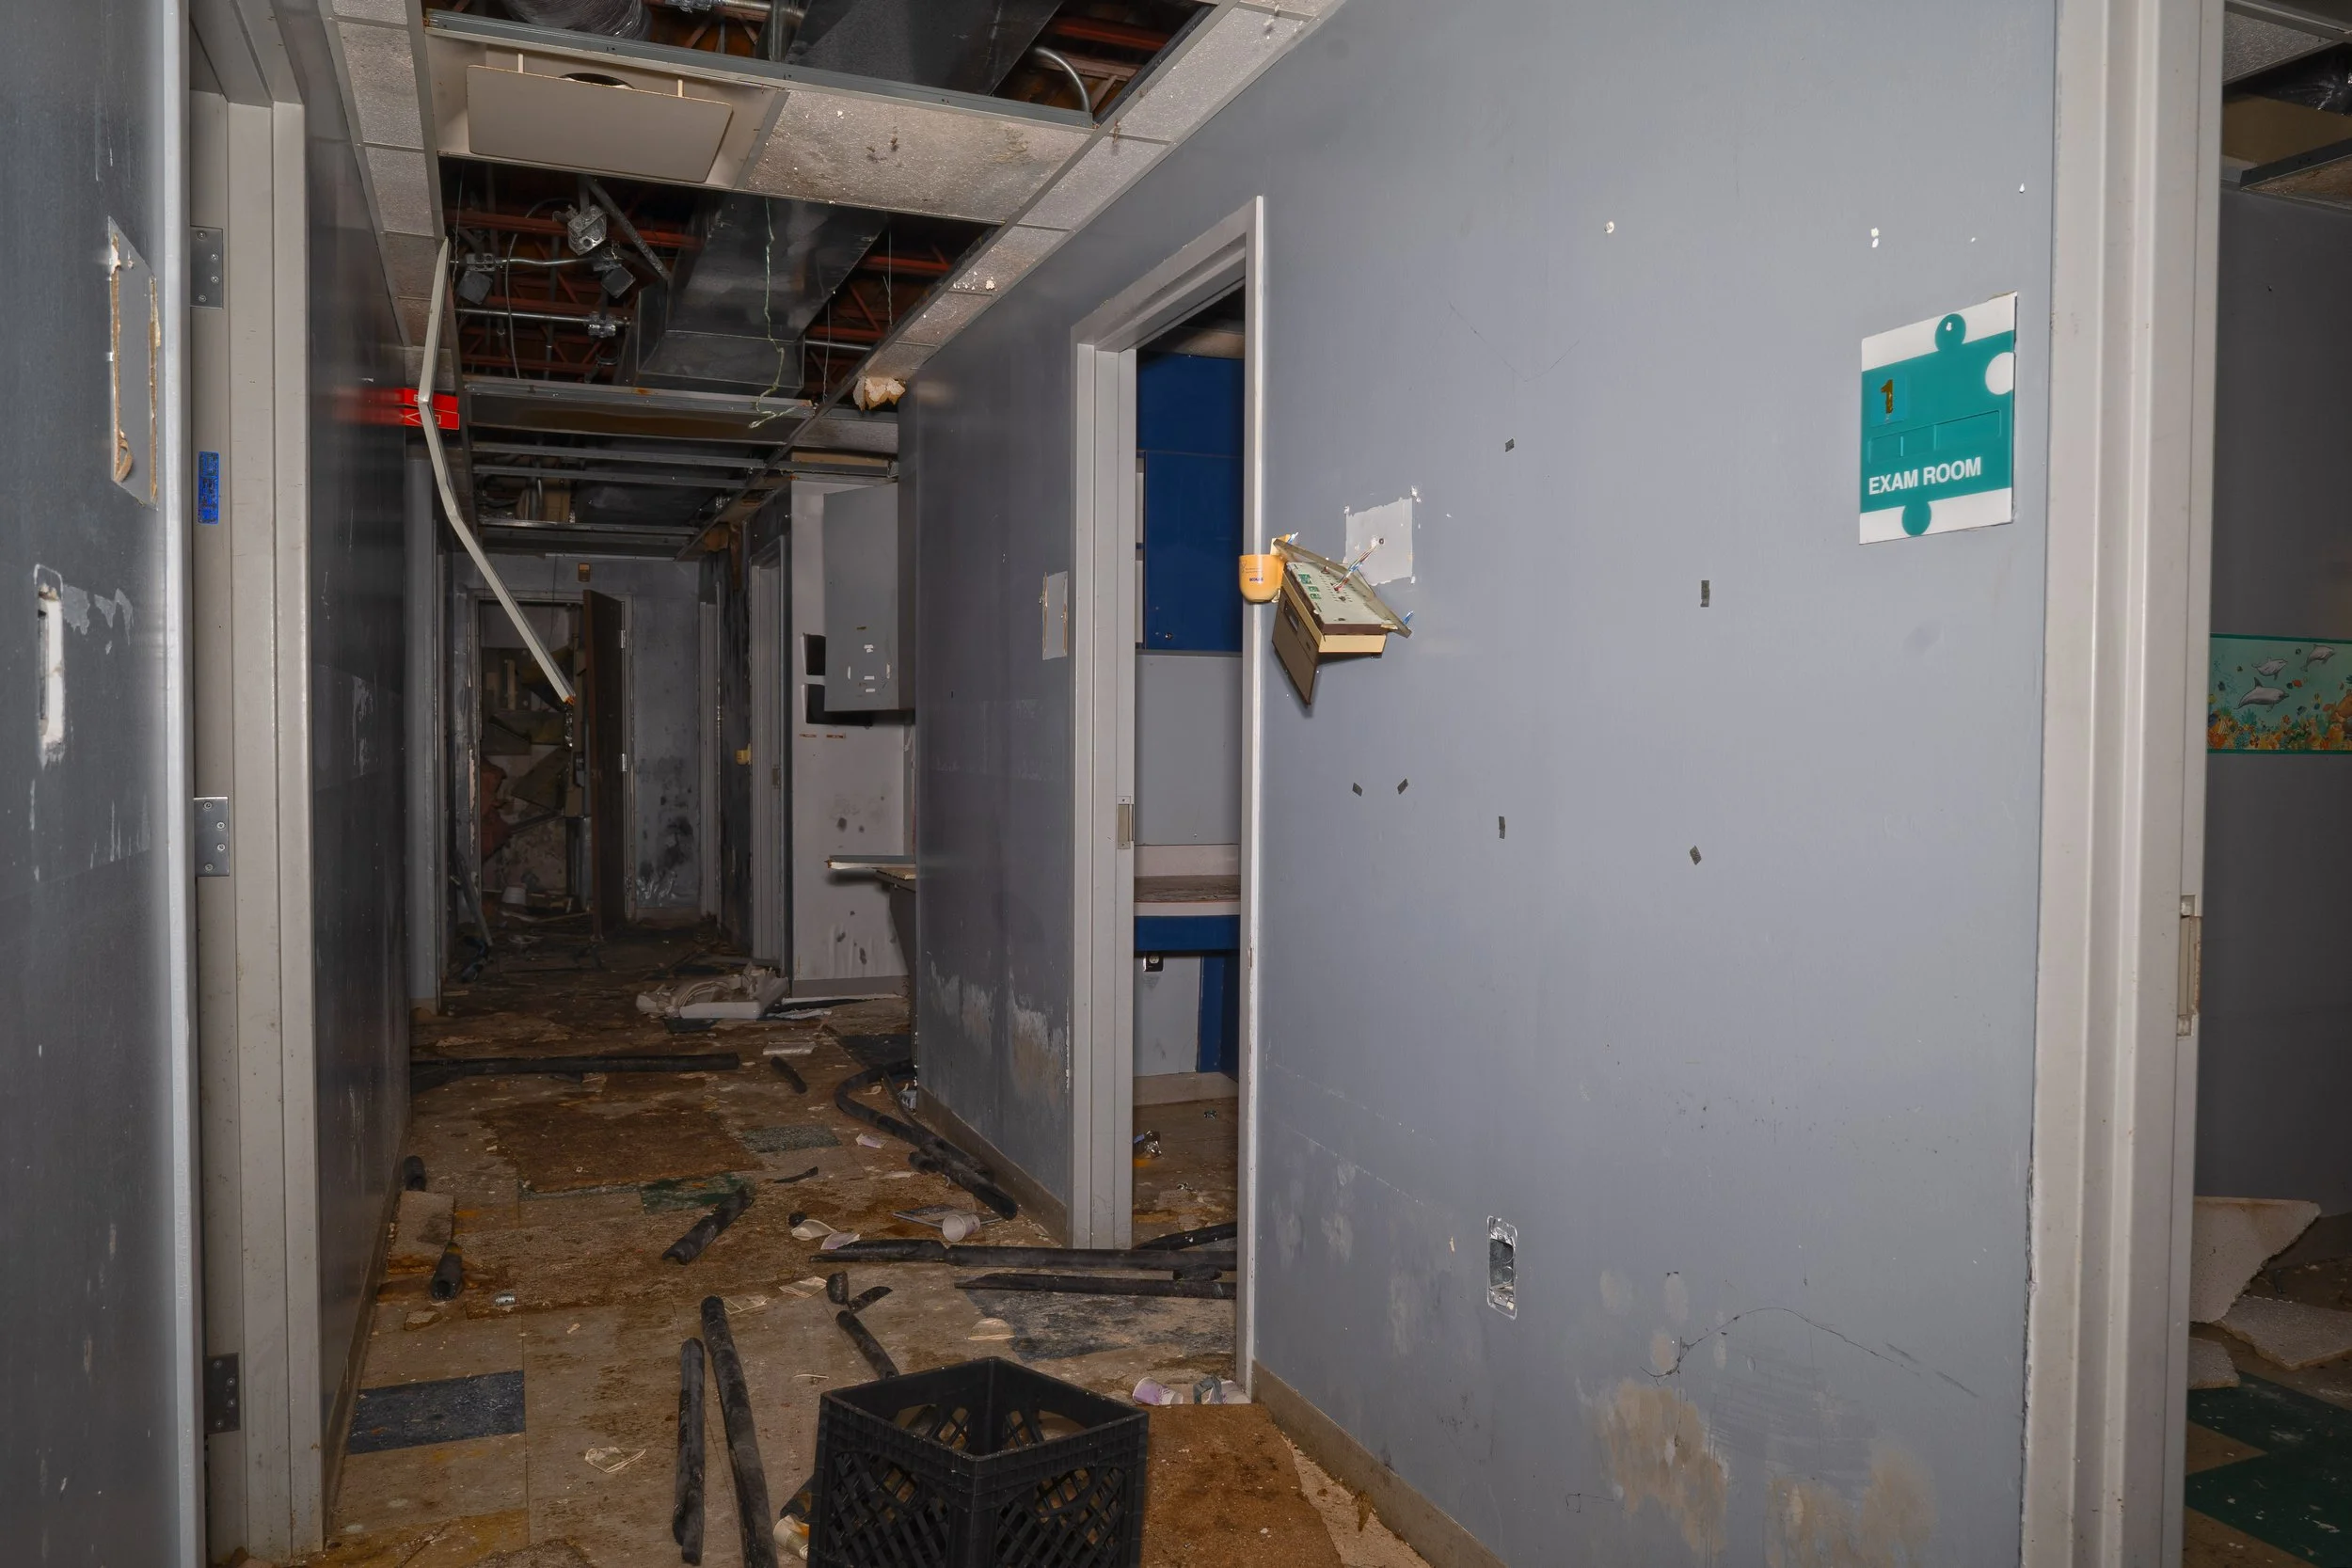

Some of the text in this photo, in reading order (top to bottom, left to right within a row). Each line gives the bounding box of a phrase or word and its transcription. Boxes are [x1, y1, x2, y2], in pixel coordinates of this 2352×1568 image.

[1881, 379, 1894, 414] 1
[1868, 456, 1981, 495] EXAM ROOM
